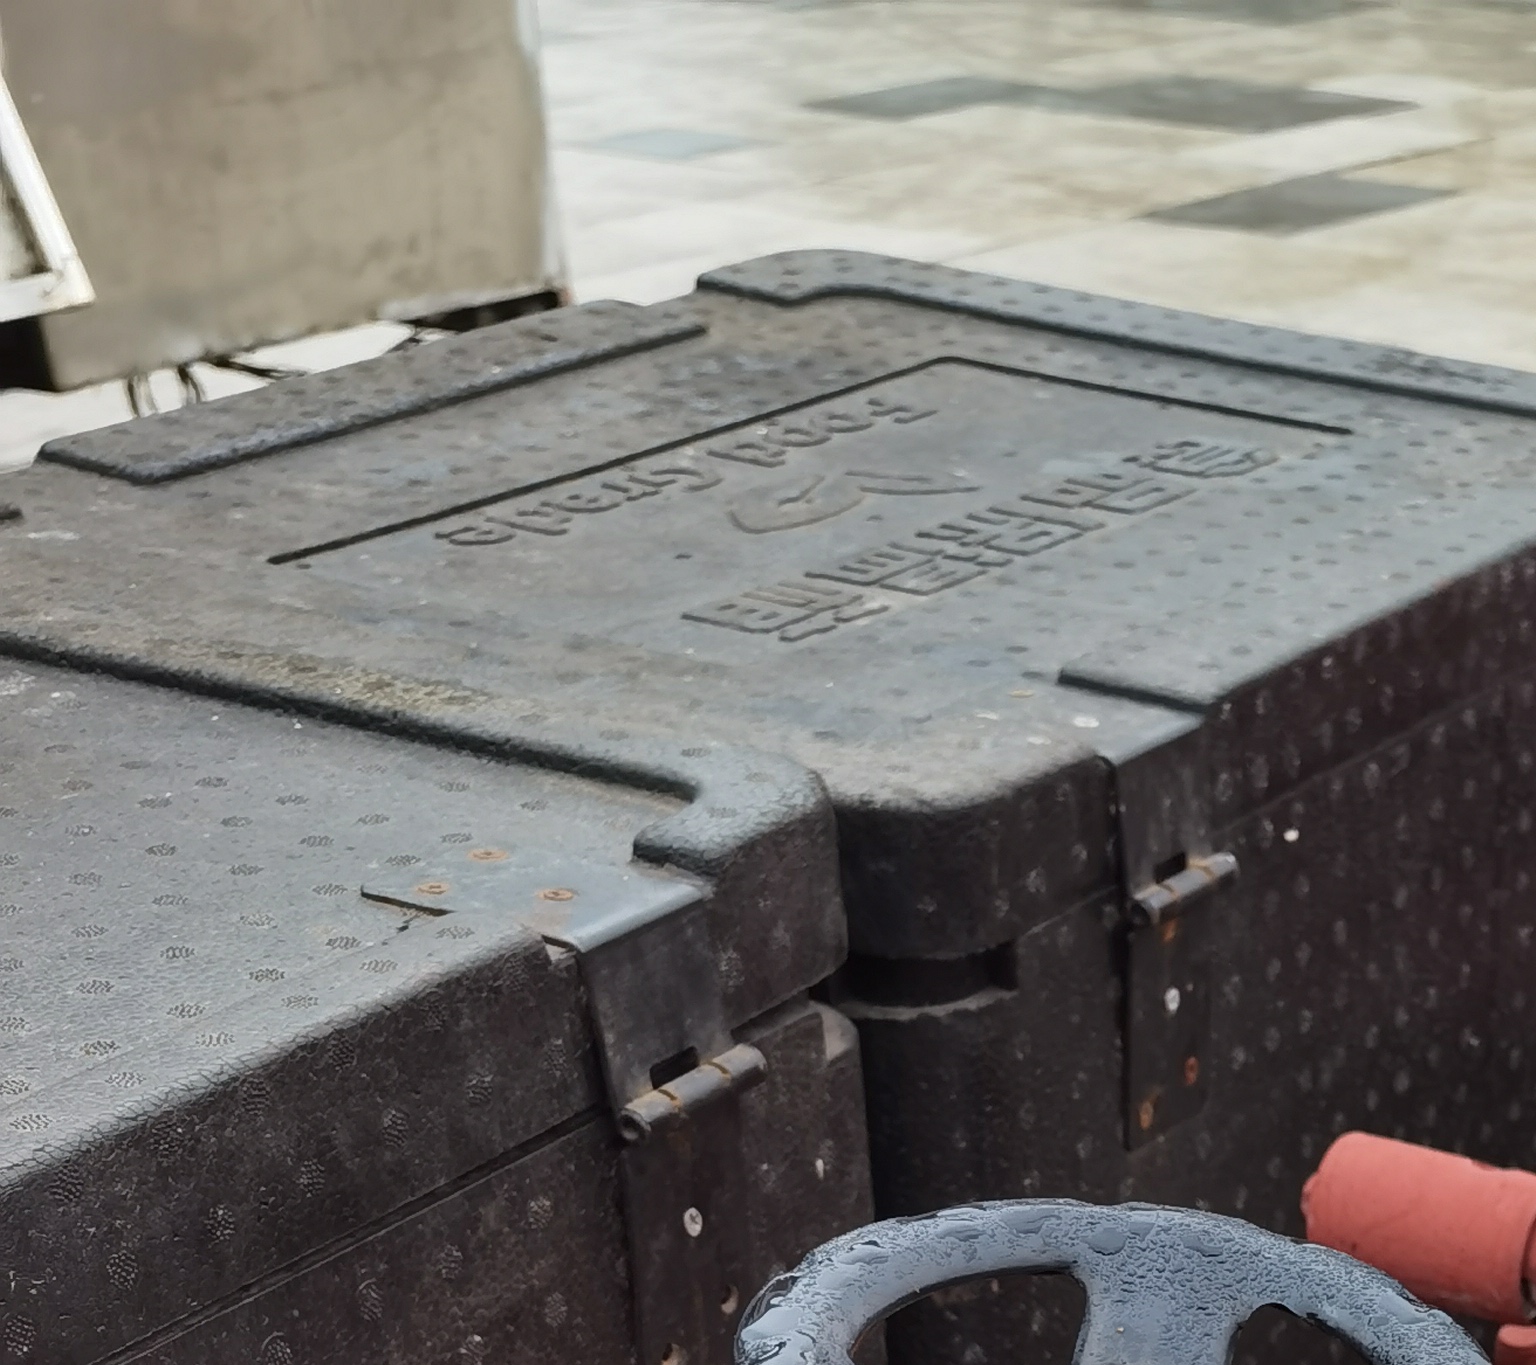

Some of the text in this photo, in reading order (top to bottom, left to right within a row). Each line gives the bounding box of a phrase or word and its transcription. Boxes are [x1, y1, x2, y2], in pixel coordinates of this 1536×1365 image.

[434, 397, 938, 546] Food Grade
[678, 440, 1280, 642] 食品保温箱
